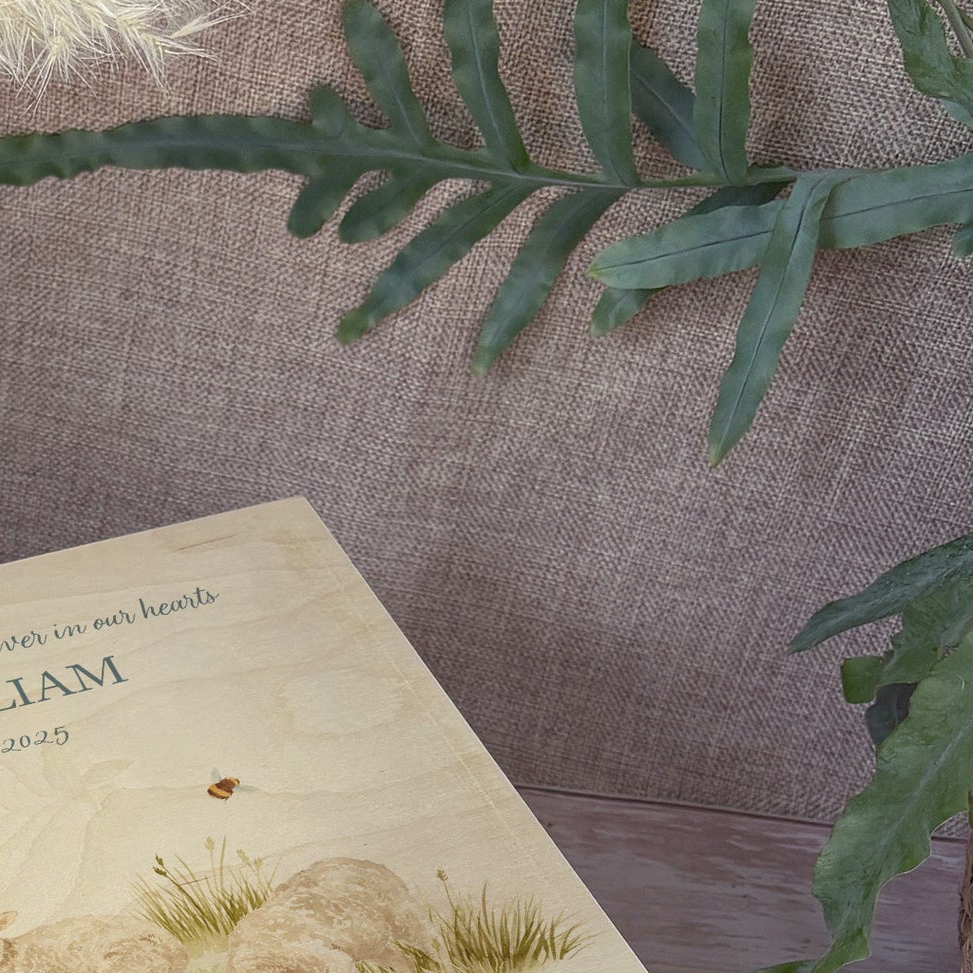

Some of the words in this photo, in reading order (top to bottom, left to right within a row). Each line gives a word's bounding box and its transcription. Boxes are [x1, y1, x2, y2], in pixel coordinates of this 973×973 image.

[54, 623, 87, 641] in
[93, 609, 137, 631] our
[139, 586, 219, 619] hearts
